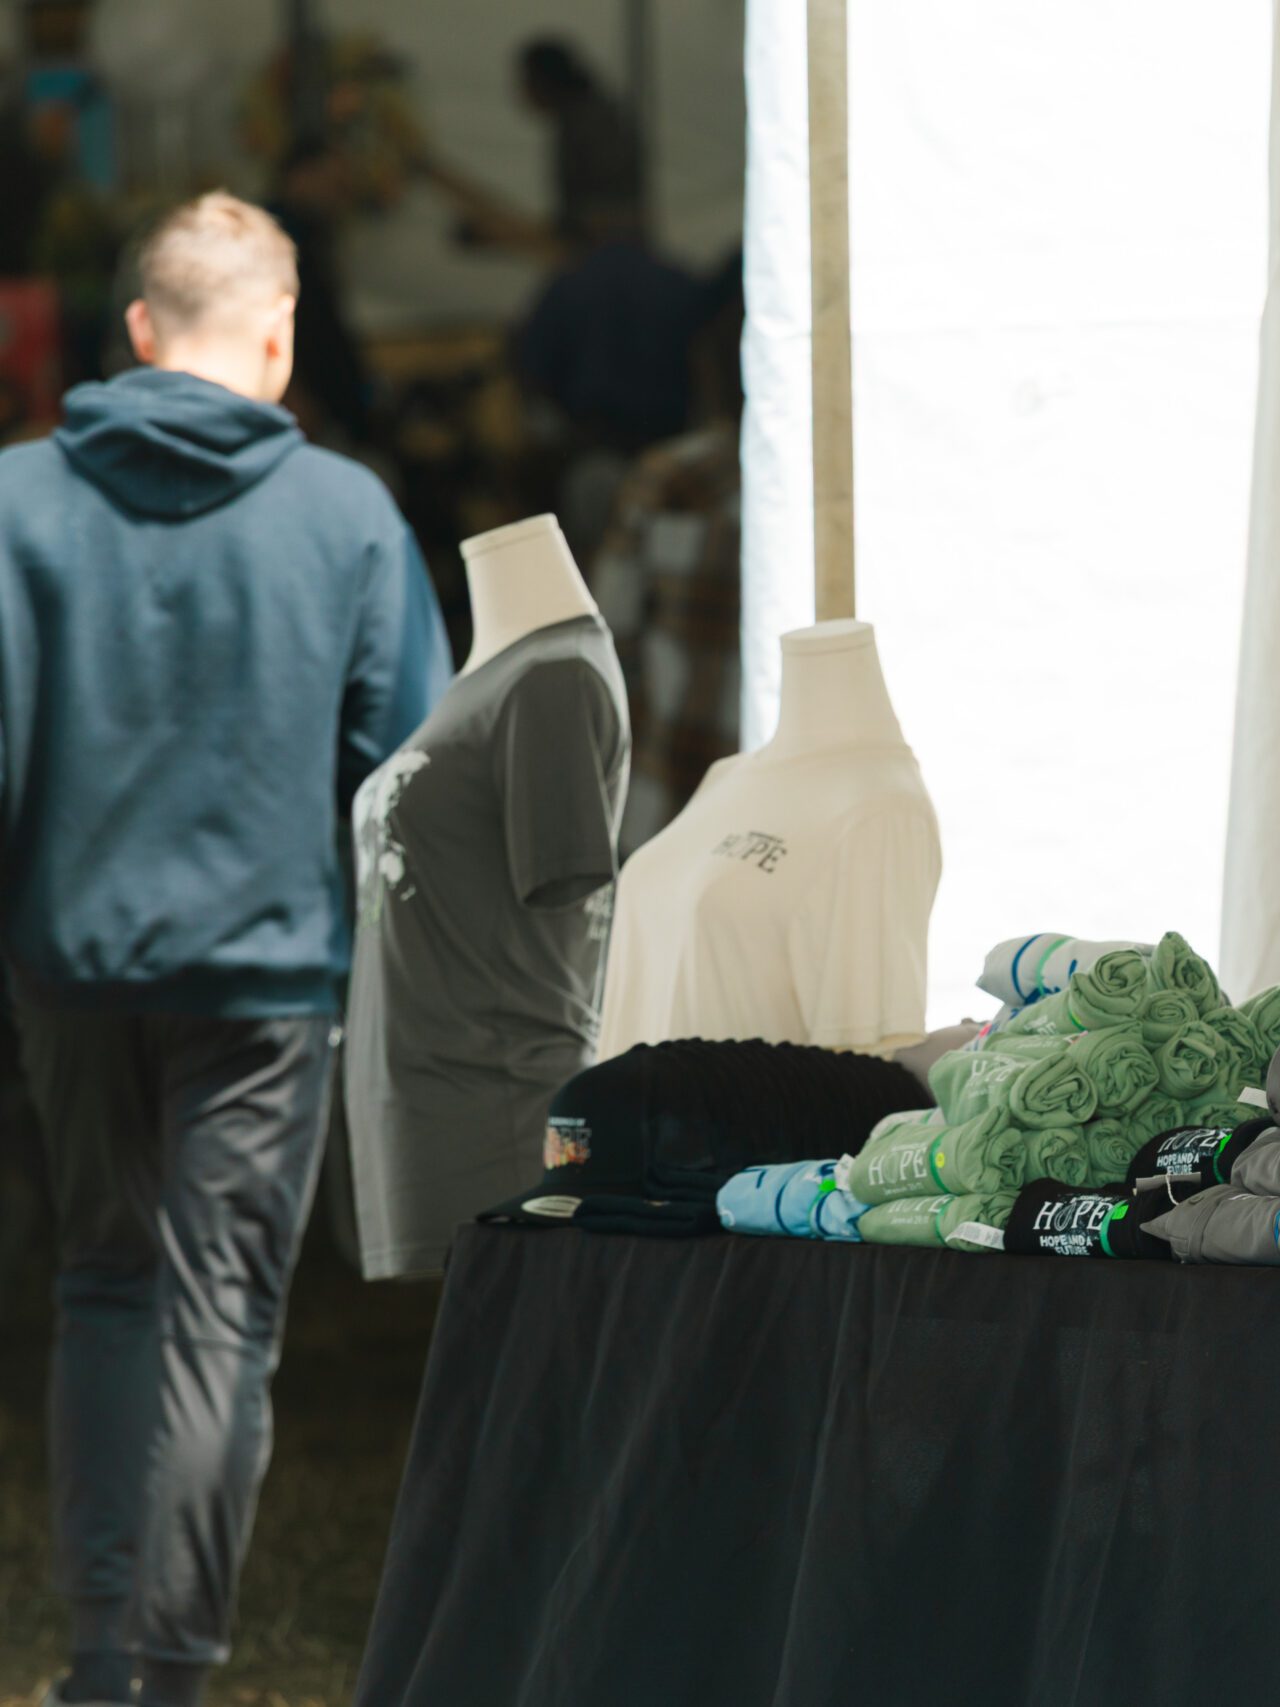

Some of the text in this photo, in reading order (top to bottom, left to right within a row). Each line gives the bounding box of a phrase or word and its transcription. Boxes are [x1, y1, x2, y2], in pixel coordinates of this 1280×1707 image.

[868, 1146, 928, 1186] HOPE
[1156, 1154, 1178, 1168] HOPE
[1178, 1152, 1194, 1166] AND
[1032, 1200, 1114, 1231] HOPE
[1040, 1233, 1094, 1248] HOPE AND A
